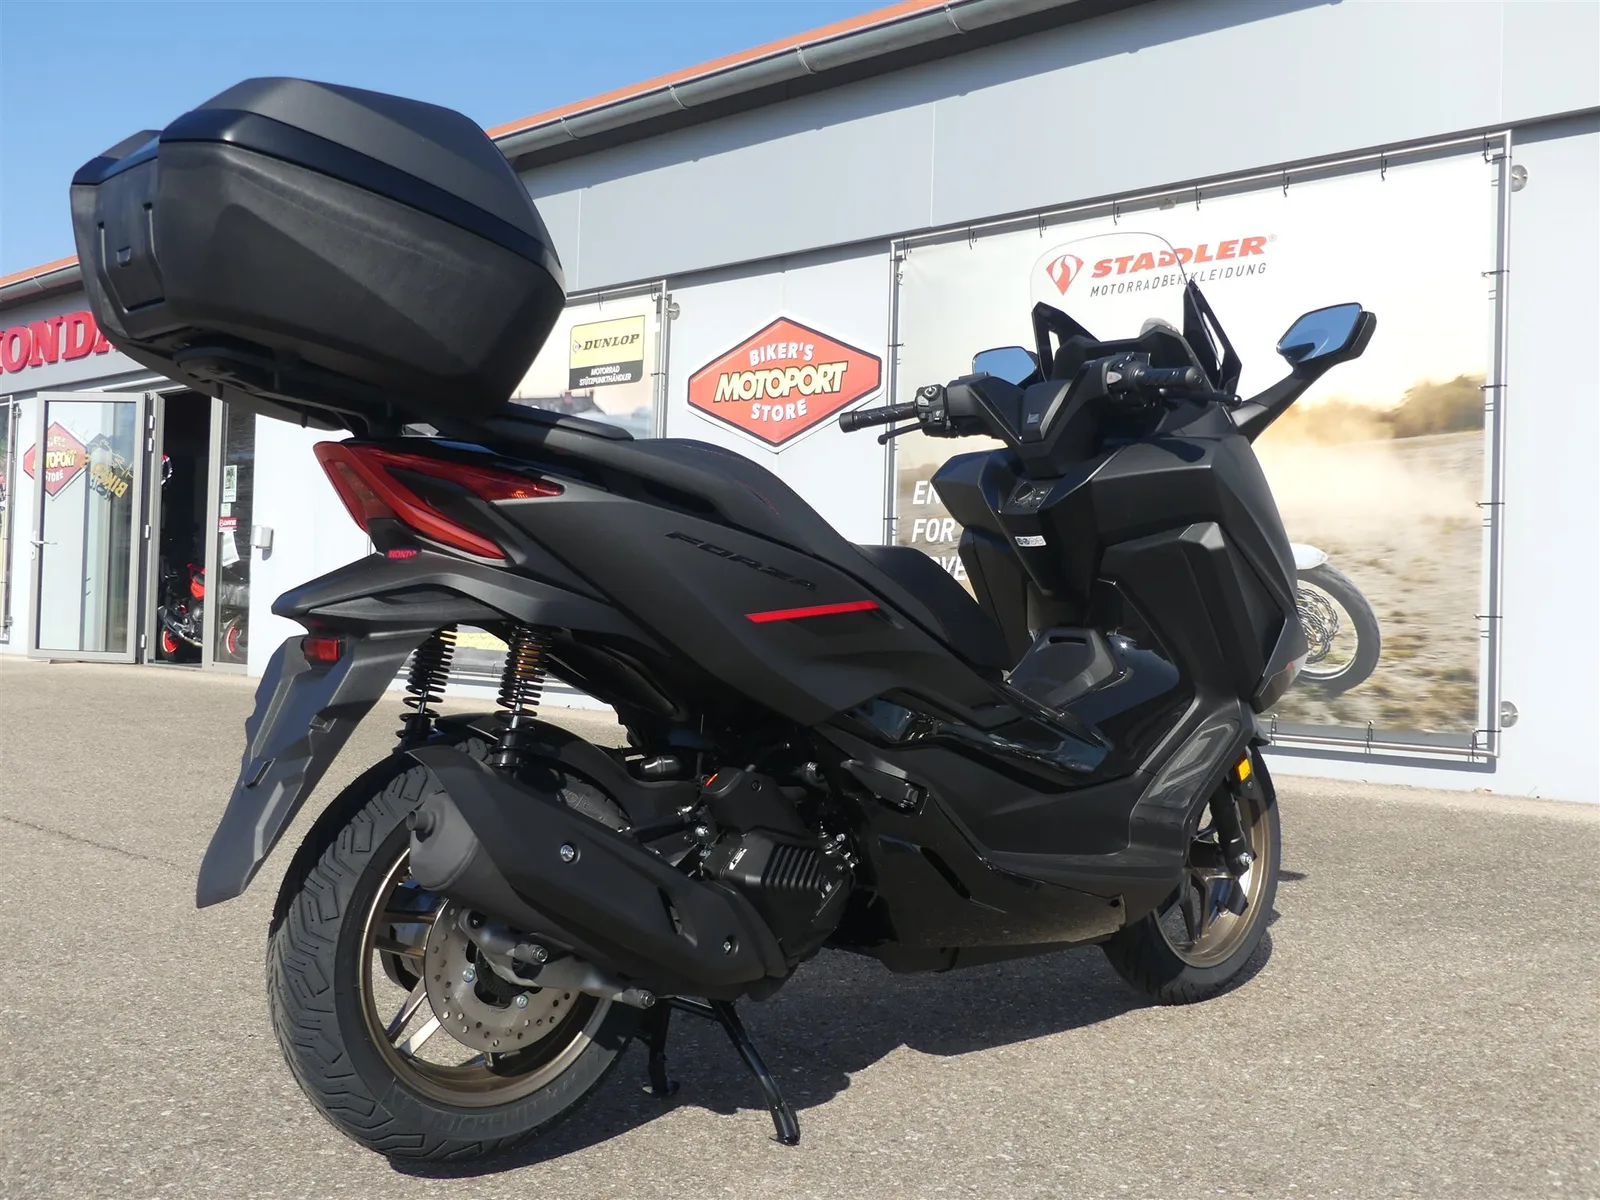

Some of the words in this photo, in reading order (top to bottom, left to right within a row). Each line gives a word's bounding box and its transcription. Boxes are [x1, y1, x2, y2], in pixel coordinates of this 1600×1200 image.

[1091, 235, 1267, 279] STADLER
[0, 310, 116, 375] OND
[582, 333, 640, 351] DUNLOP
[749, 341, 815, 367] BIKER'S
[590, 365, 621, 376] MOTORRAD
[712, 361, 849, 403] MOTOPORT
[750, 398, 808, 422] STORE
[911, 518, 956, 543] FOR
[664, 530, 817, 592] FORZA
